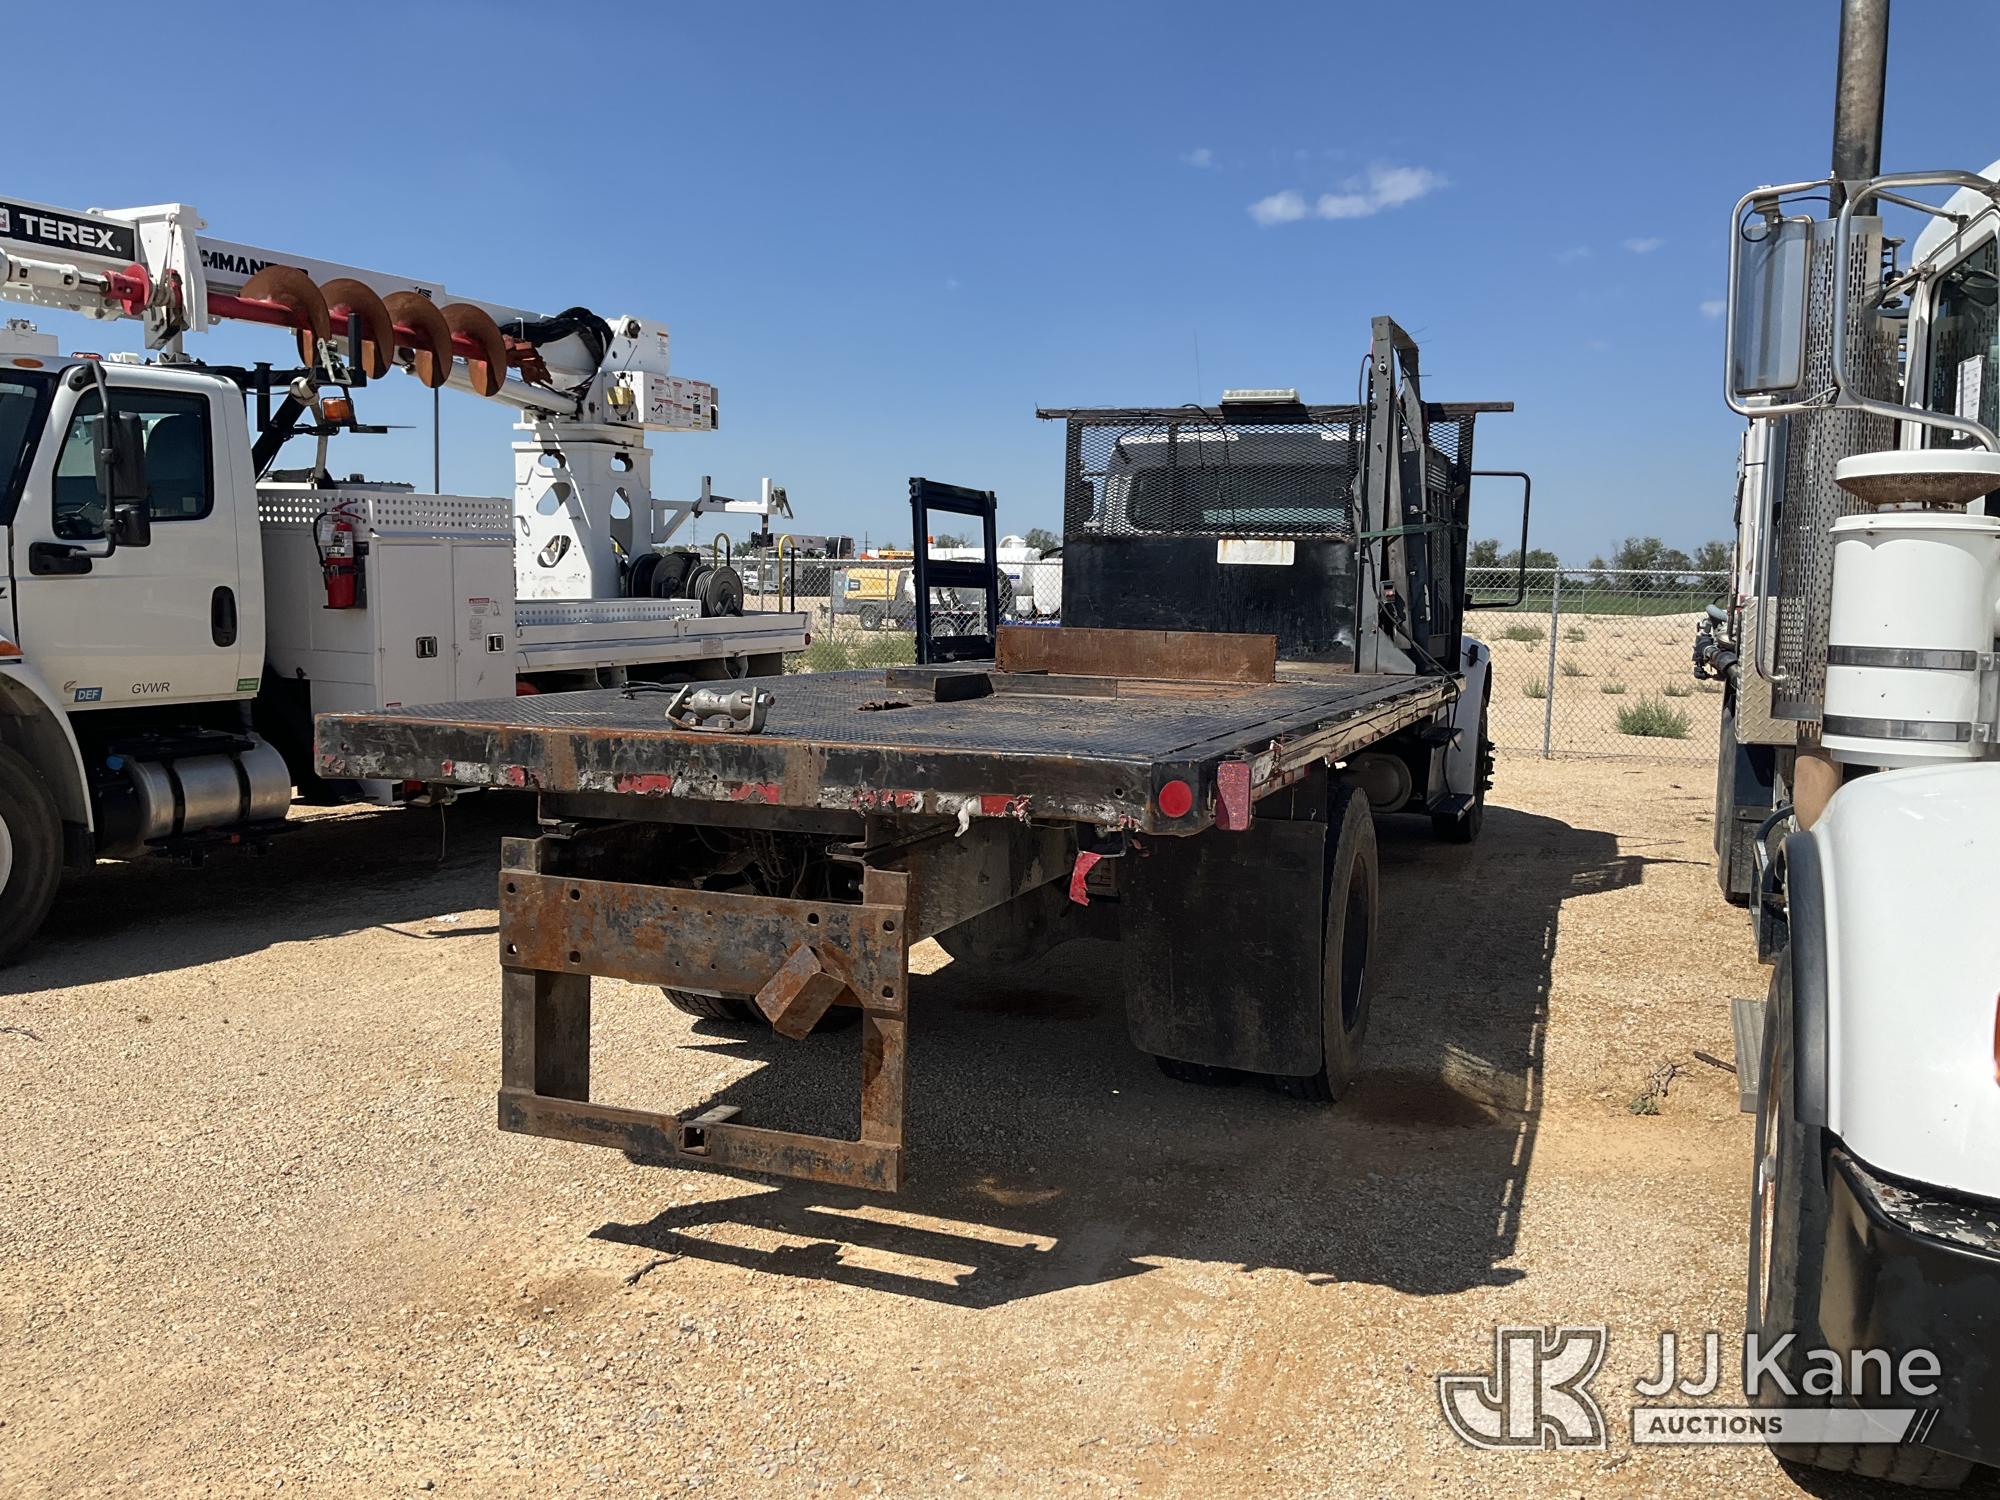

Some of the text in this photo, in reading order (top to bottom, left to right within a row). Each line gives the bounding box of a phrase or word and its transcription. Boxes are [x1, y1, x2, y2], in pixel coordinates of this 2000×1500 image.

[19, 213, 116, 251] TEREX
[131, 682, 170, 694] GVWR
[78, 690, 99, 700] DEF
